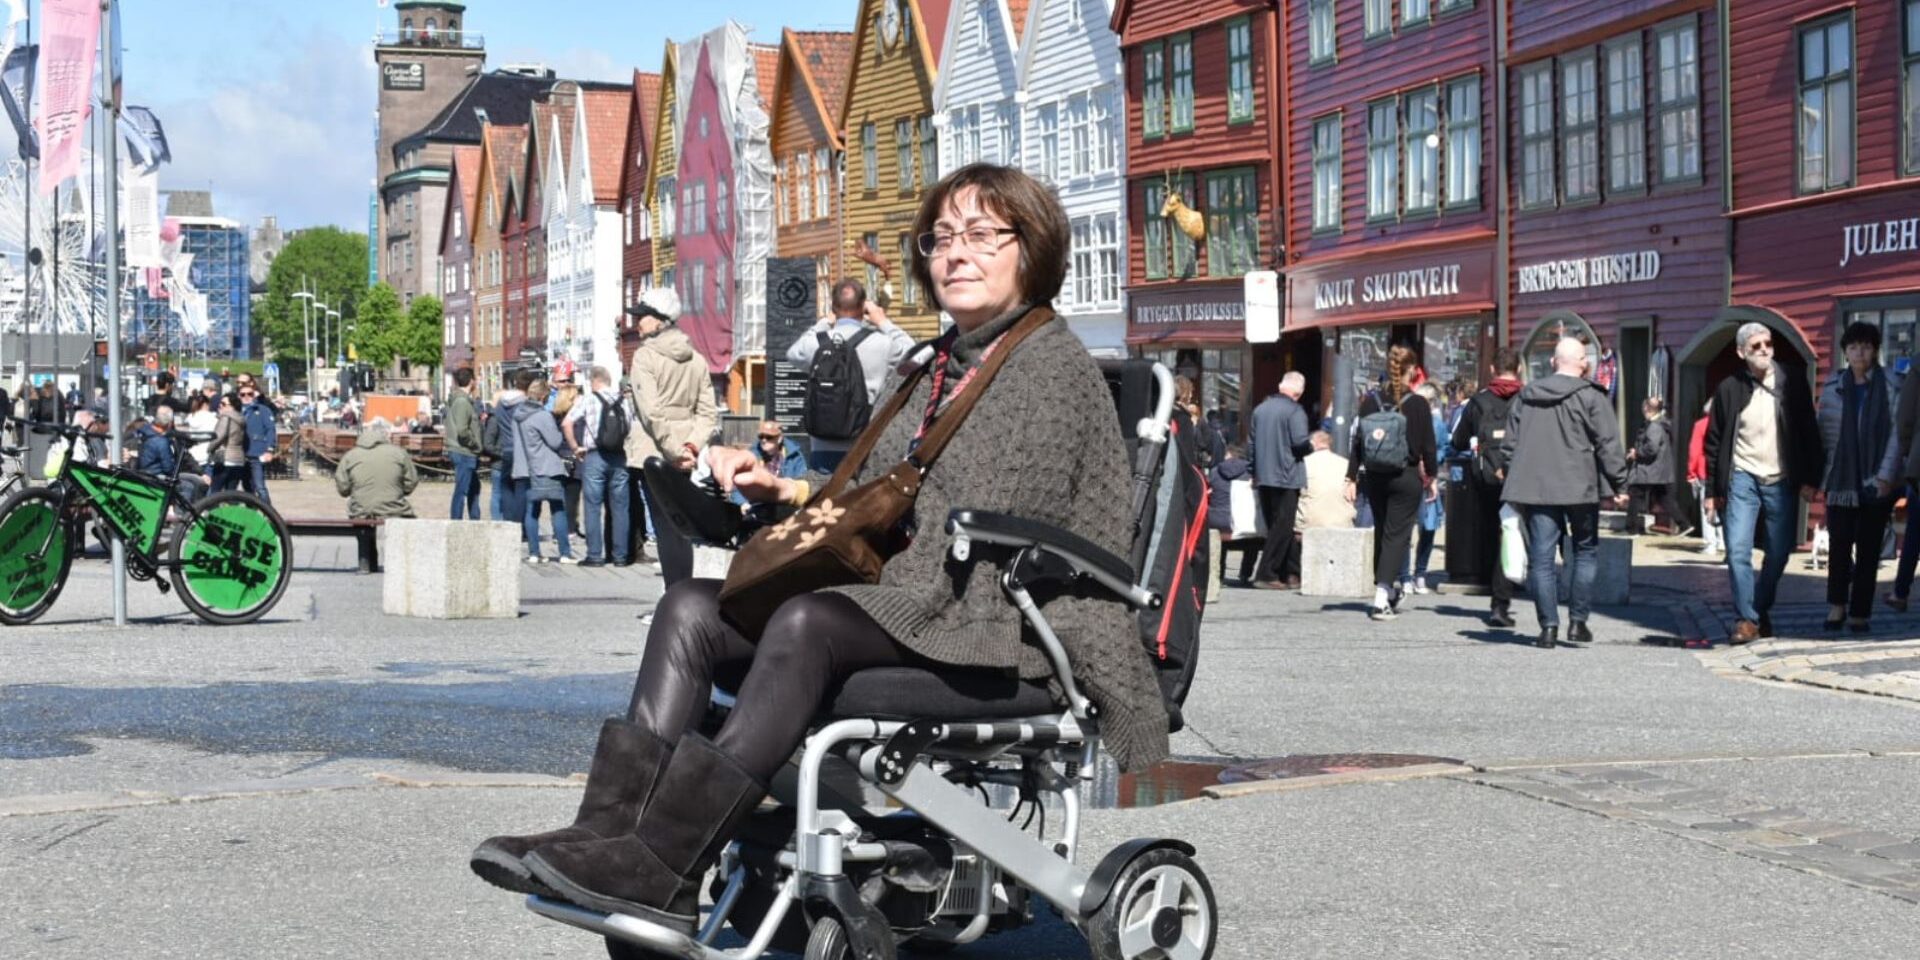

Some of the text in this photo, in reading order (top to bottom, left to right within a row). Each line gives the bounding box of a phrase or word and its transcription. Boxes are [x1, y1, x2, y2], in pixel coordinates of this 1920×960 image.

[1314, 264, 1461, 310] KNUT SKURTVEIT
[1518, 249, 1661, 294] BRYGGEN HUSFLID
[1136, 305, 1183, 324] BRYGGEN
[105, 494, 147, 547] RENTAL
[116, 492, 146, 526] BIKE
[201, 522, 277, 566] BASE
[191, 549, 268, 590] CAMP
